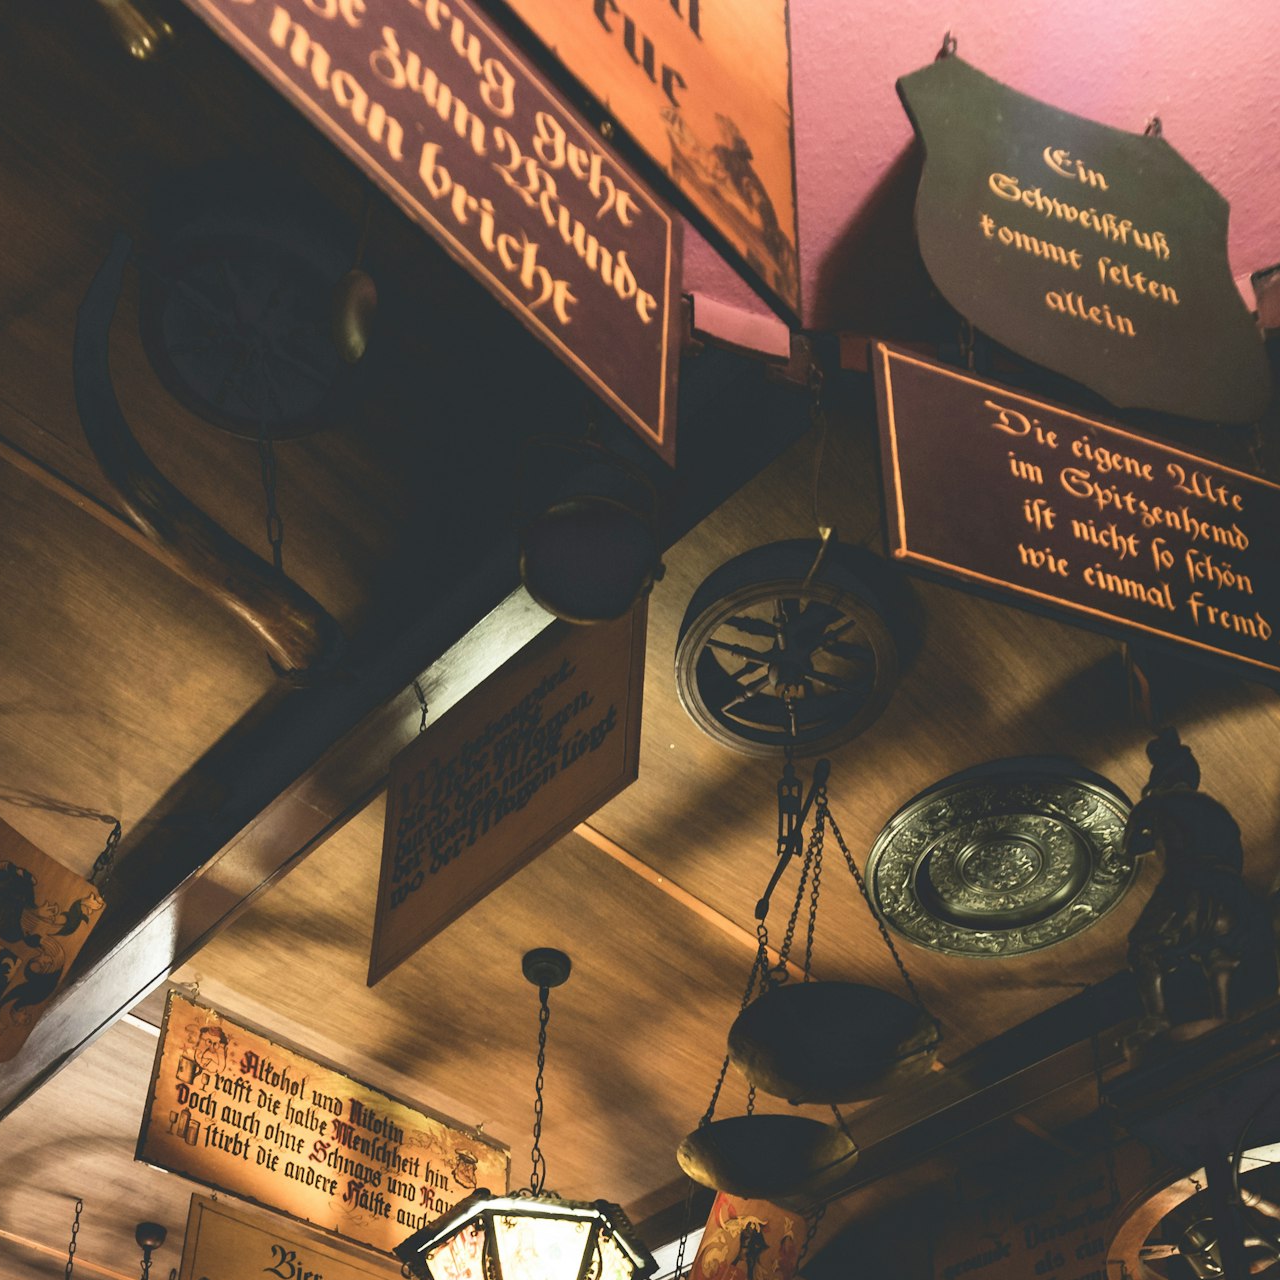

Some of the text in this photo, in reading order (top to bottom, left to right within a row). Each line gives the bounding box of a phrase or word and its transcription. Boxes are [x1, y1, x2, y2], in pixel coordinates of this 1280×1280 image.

[269, 6, 404, 162] man
[419, 143, 578, 325] bricht
[369, 27, 487, 157] zum
[491, 127, 658, 325] Munde
[532, 111, 642, 228] geht
[1042, 146, 1109, 192] Ein
[979, 211, 1180, 305] kommt selten
[989, 173, 1170, 260] Schweißfuß
[1044, 289, 1136, 337] allein
[984, 399, 1245, 512] Die eigene Alte
[1008, 451, 1250, 552] im Spitzenhemd
[1018, 543, 1070, 577] wie
[1083, 564, 1176, 612] einmal
[1023, 498, 1254, 595] ist nicht so schön
[175, 1083, 216, 1117] Doch
[221, 1109, 260, 1143] auch
[264, 1122, 305, 1154] ohne
[309, 1139, 382, 1187] Schnaps
[388, 1173, 415, 1201] und
[240, 1050, 404, 1145] Alkohol und Nikotin
[257, 1085, 280, 1115] die
[286, 1099, 327, 1136] halbe
[330, 1119, 420, 1178] Menschheit
[204, 1123, 249, 1160] stirbt
[257, 1143, 278, 1172] die
[284, 1159, 337, 1196] andere
[343, 1179, 391, 1219] Hälfte
